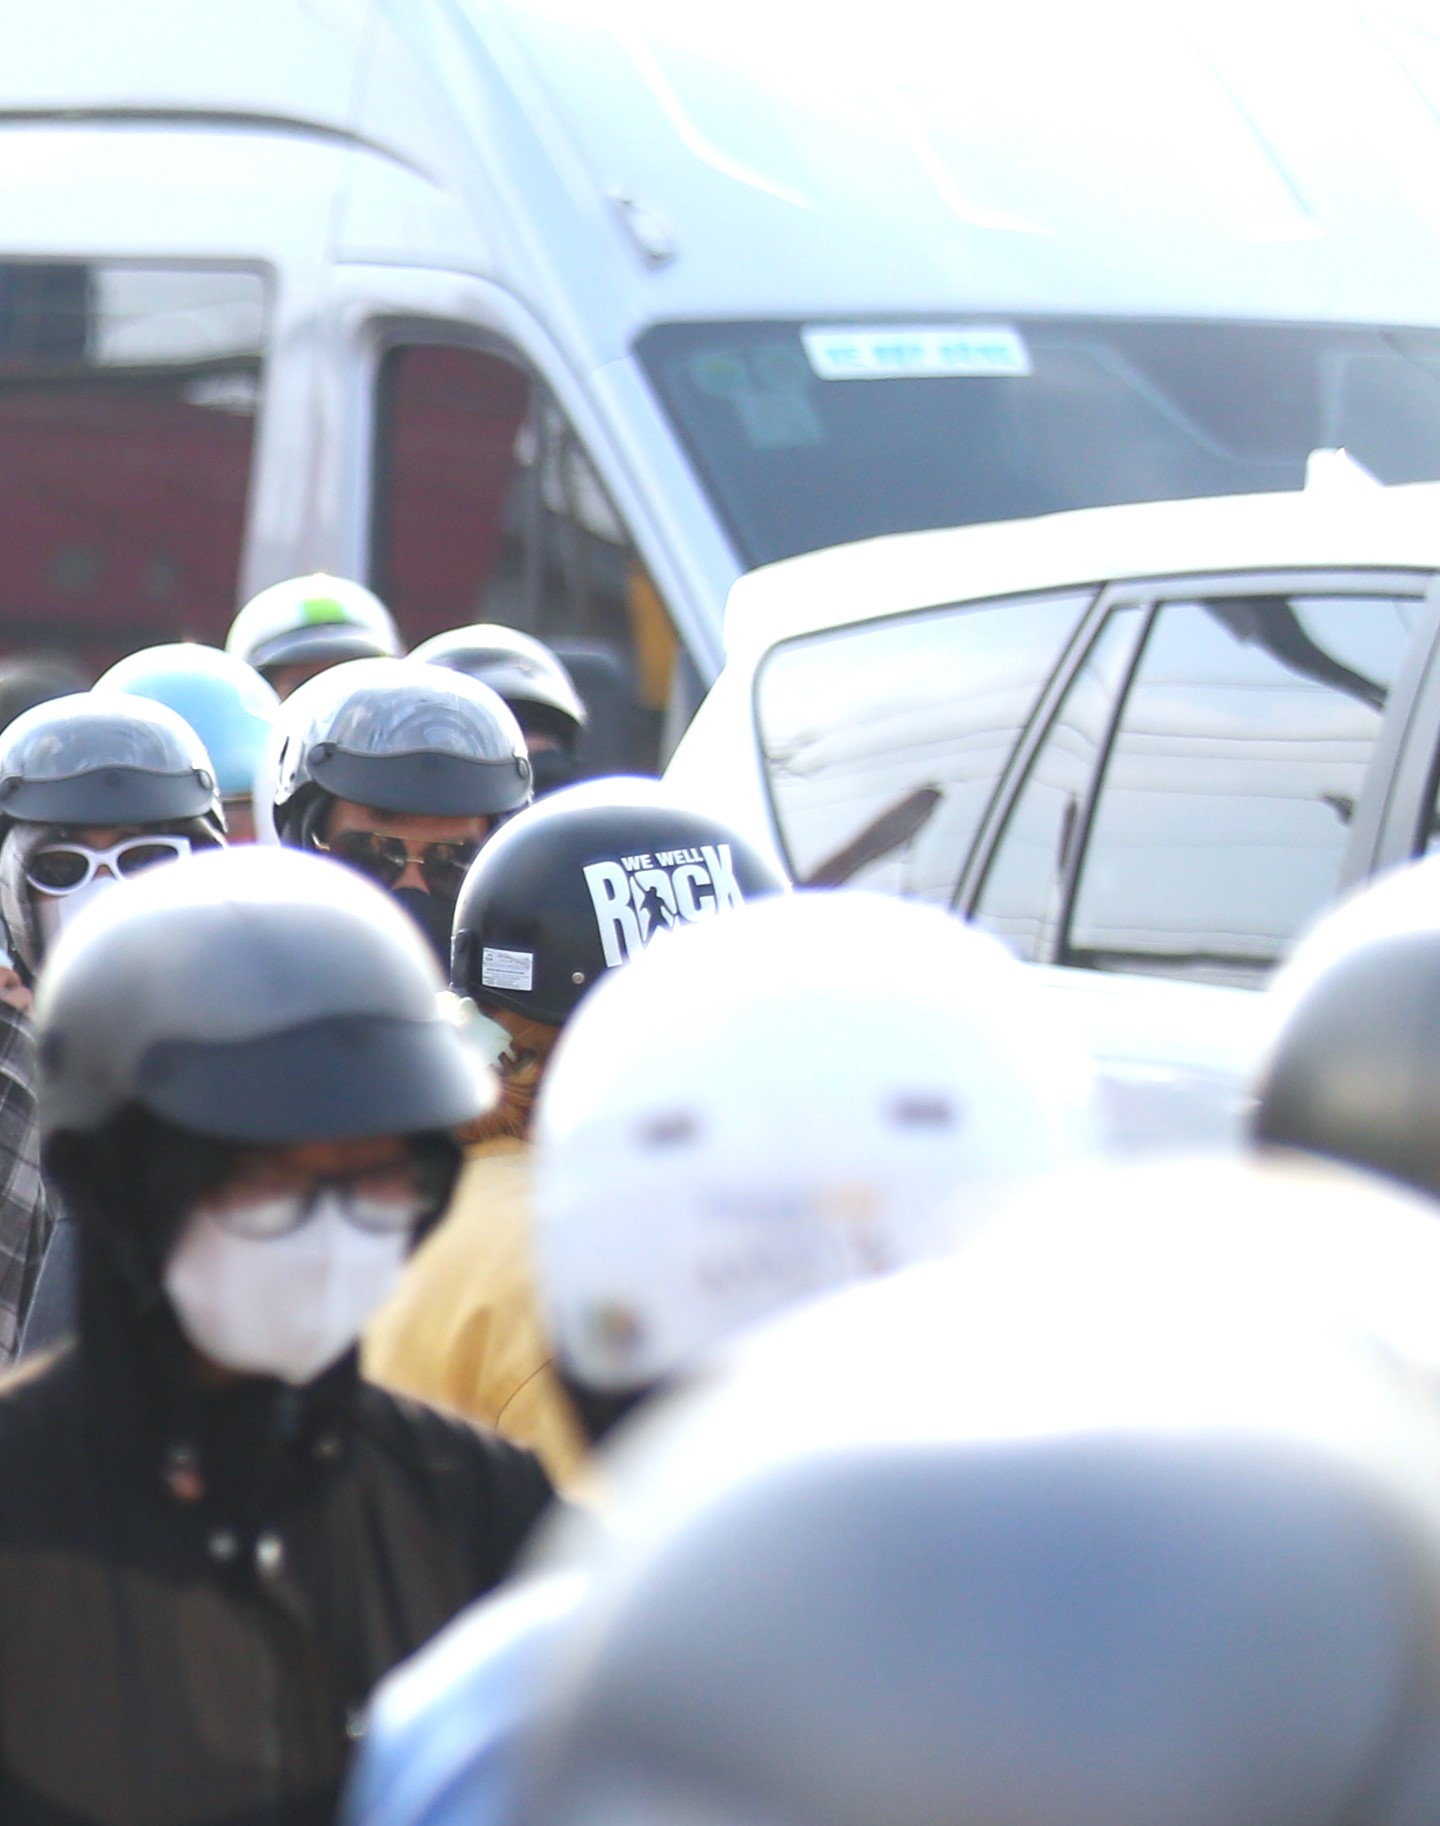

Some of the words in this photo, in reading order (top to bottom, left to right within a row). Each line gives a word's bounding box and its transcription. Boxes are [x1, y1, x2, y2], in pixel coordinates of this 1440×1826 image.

[621, 854, 654, 871] WE
[655, 848, 704, 868] WELL
[583, 844, 746, 968] ROCK
